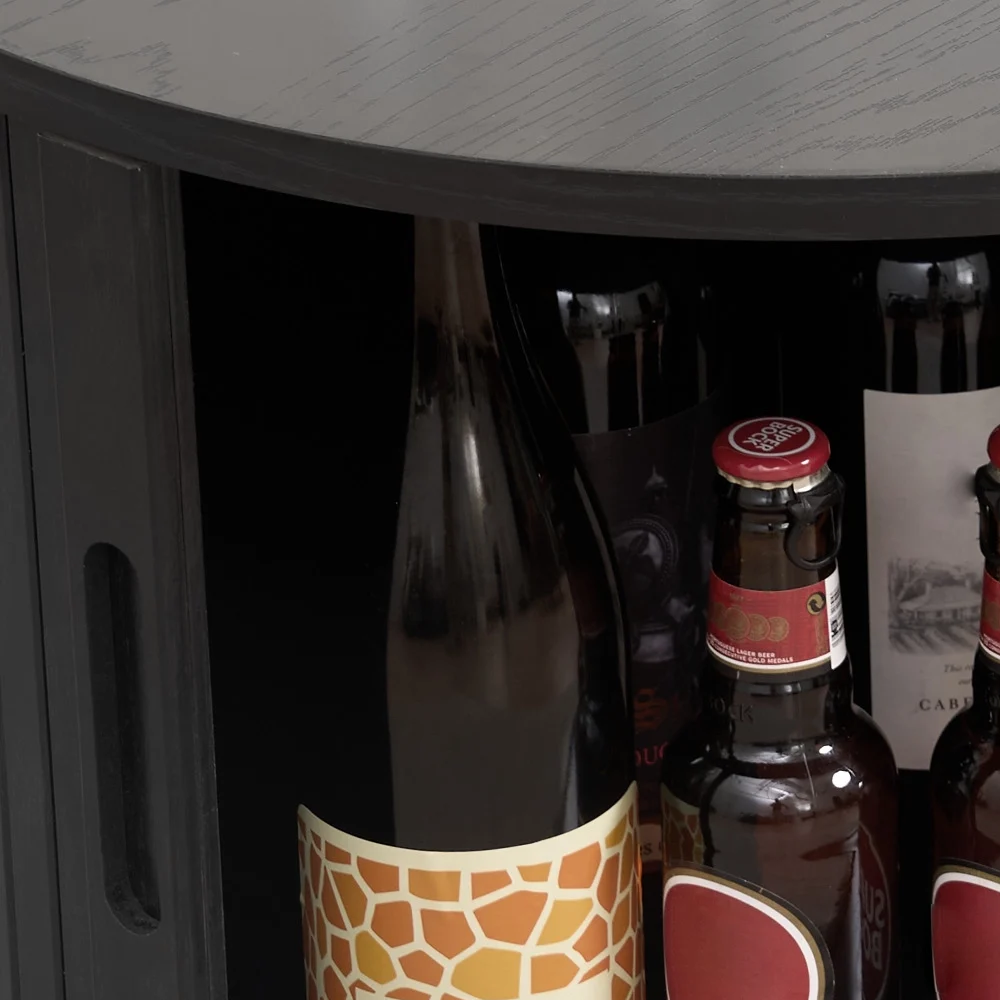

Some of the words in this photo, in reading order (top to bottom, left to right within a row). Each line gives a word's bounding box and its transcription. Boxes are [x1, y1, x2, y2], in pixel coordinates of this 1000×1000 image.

[742, 421, 787, 446] BOCK
[755, 424, 803, 452] SUPER
[736, 648, 756, 657] LAGER
[767, 656, 794, 664] MEDALS
